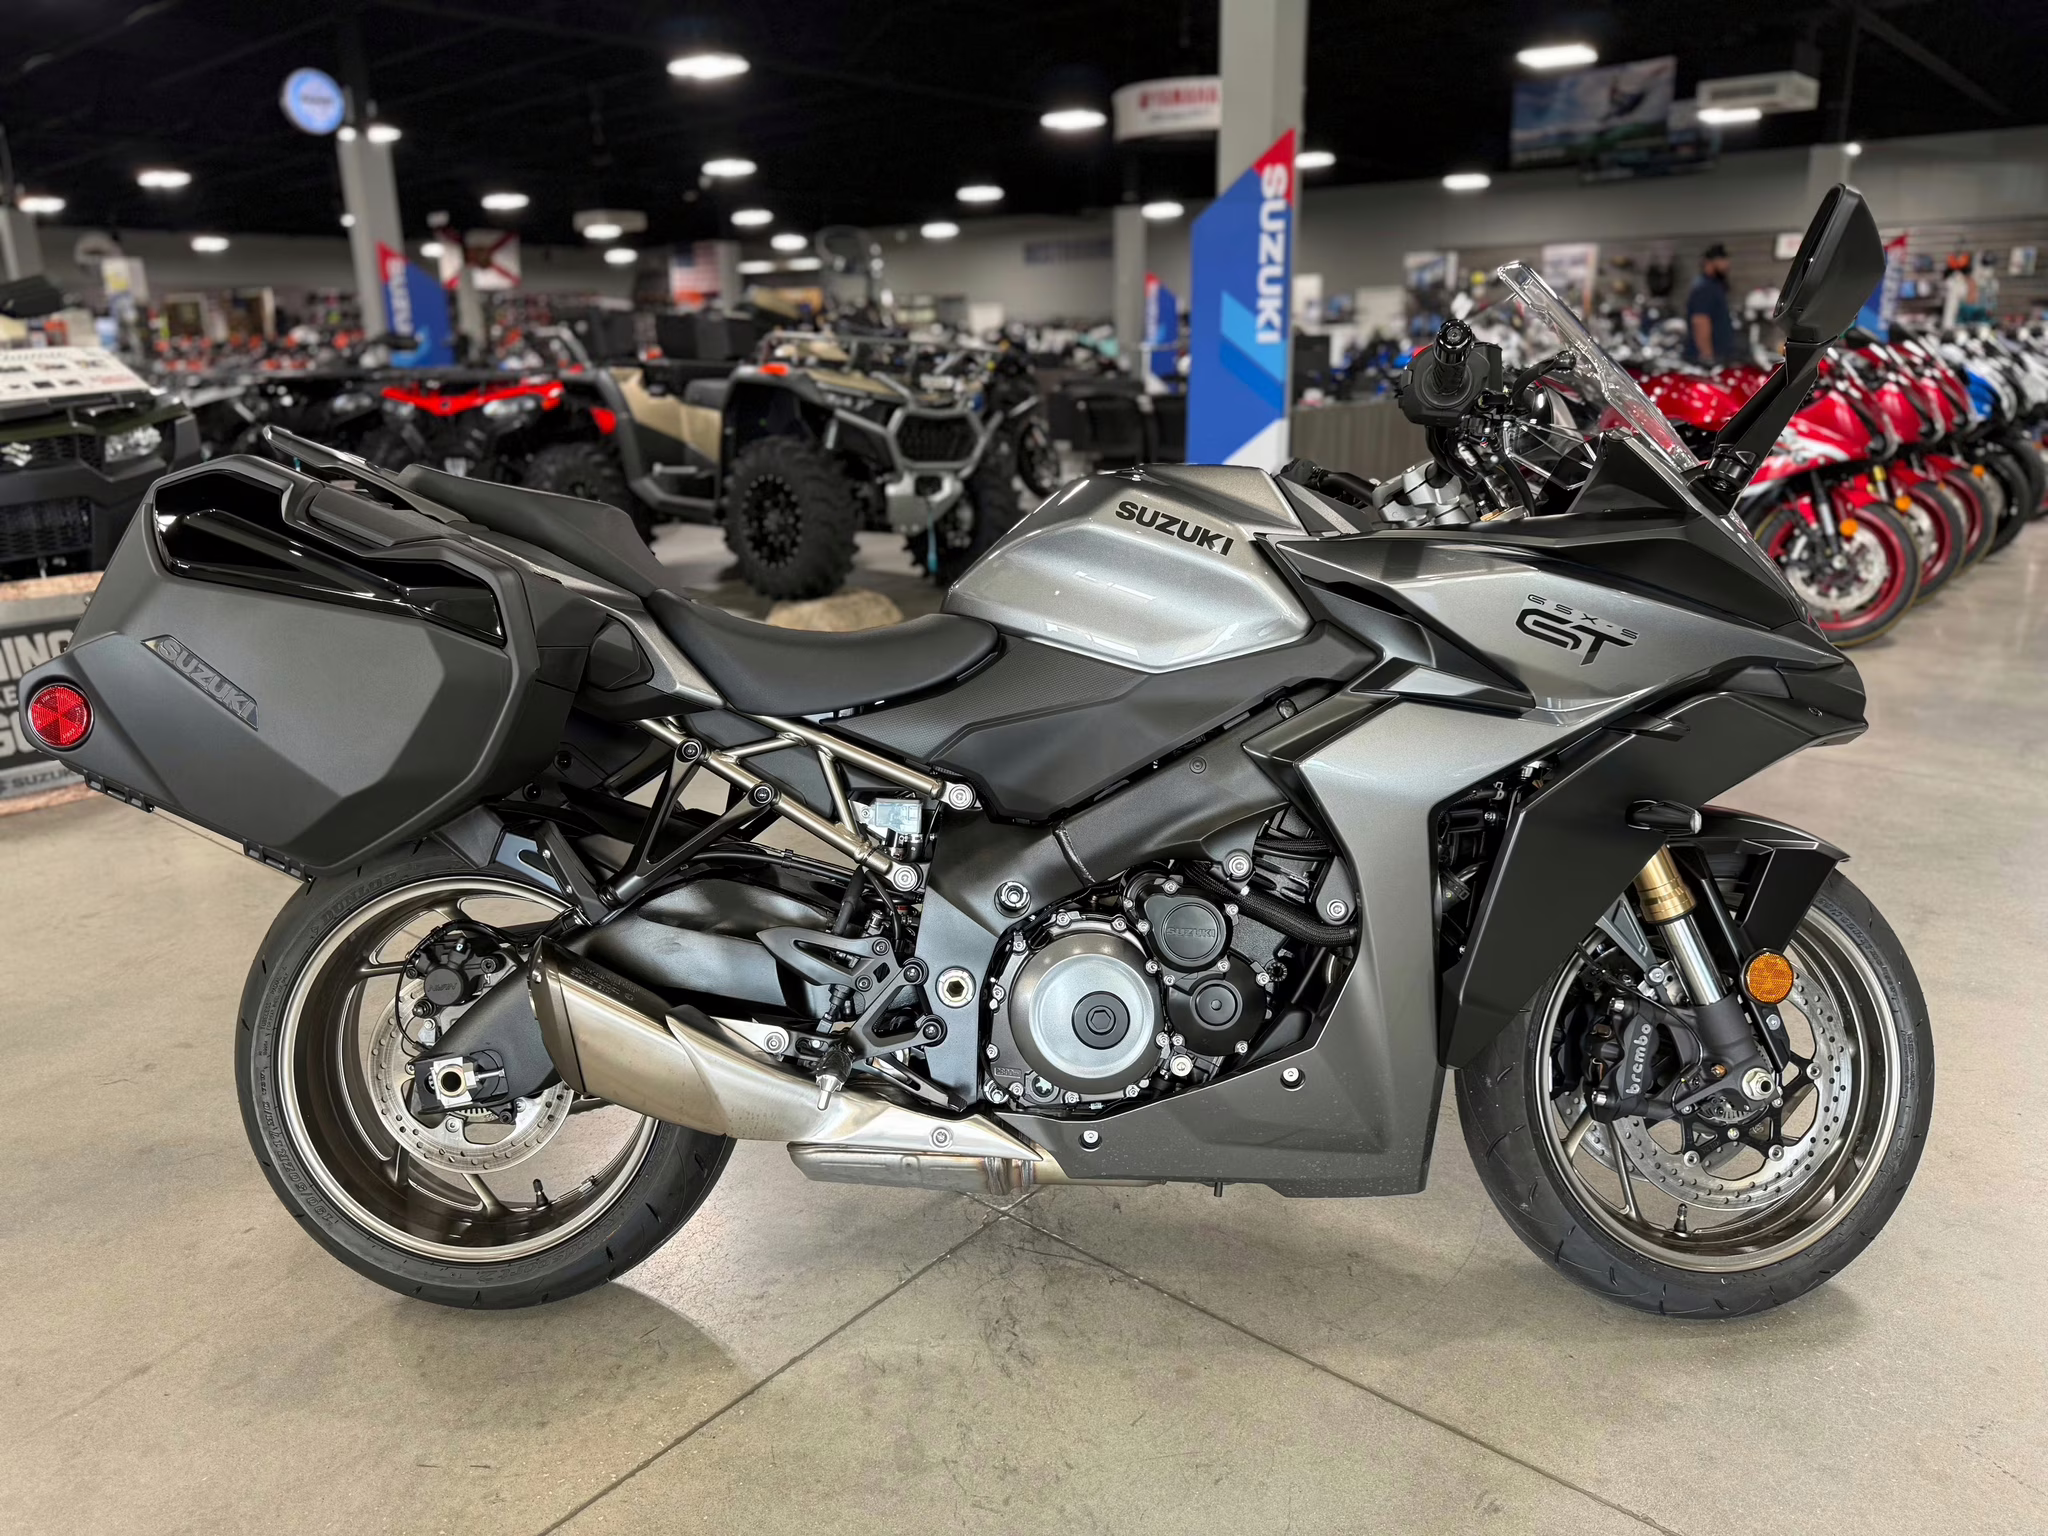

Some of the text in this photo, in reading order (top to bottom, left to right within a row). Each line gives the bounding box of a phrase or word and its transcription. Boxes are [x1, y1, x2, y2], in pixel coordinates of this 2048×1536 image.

[1256, 163, 1289, 345] SUZUKI
[1115, 500, 1234, 557] SUZUKI
[1515, 608, 1634, 666] GT
[158, 639, 257, 720] SUZUKI
[1167, 927, 1215, 938] SUZUKI
[1625, 1023, 1652, 1095] brembo
